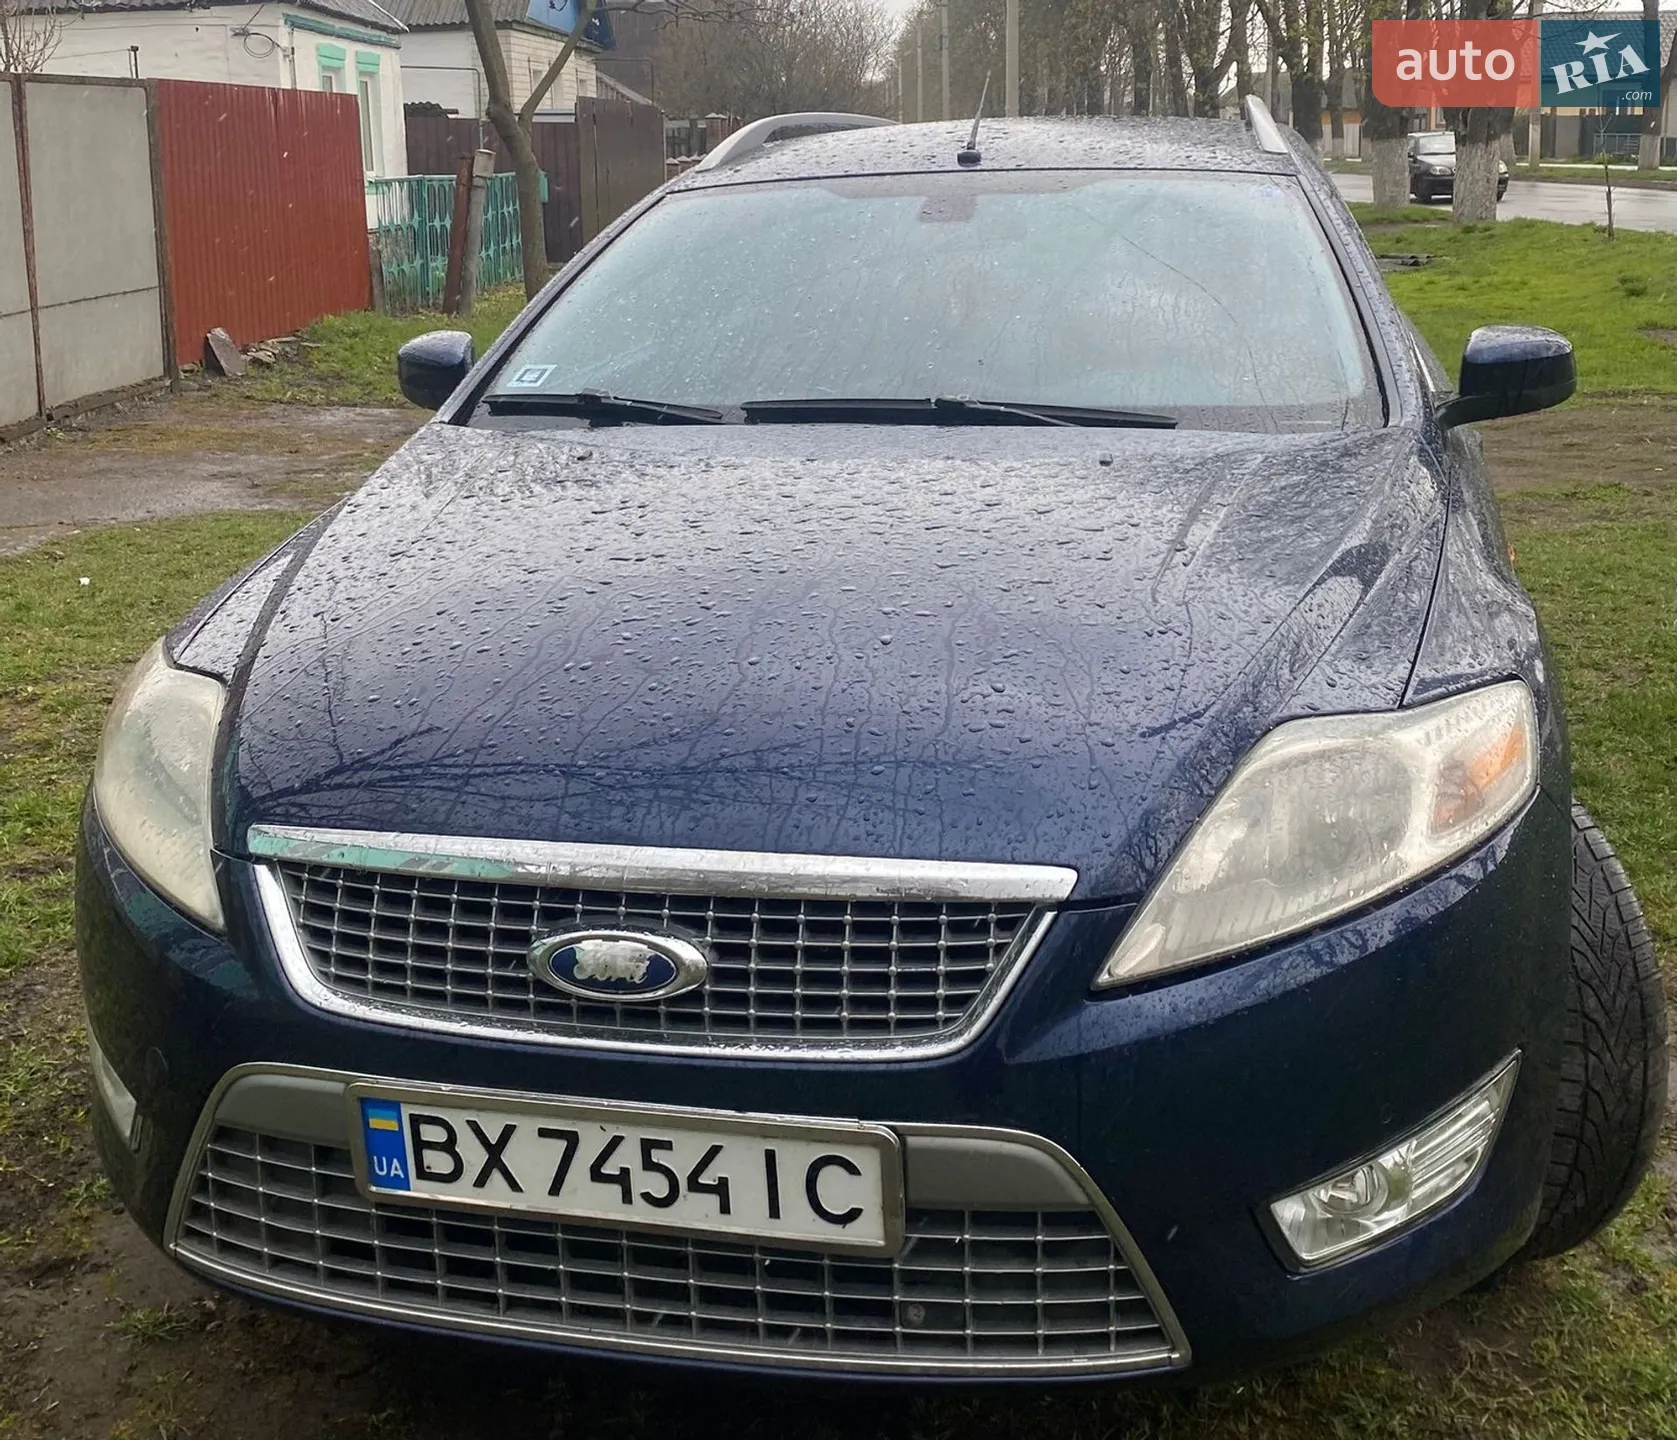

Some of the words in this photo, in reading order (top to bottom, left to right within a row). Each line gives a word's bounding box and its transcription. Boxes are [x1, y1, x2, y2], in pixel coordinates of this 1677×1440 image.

[373, 1155, 405, 1179] UA
[408, 1112, 524, 1194] BX
[537, 1127, 732, 1216] 7454
[763, 1147, 864, 1226] IC
